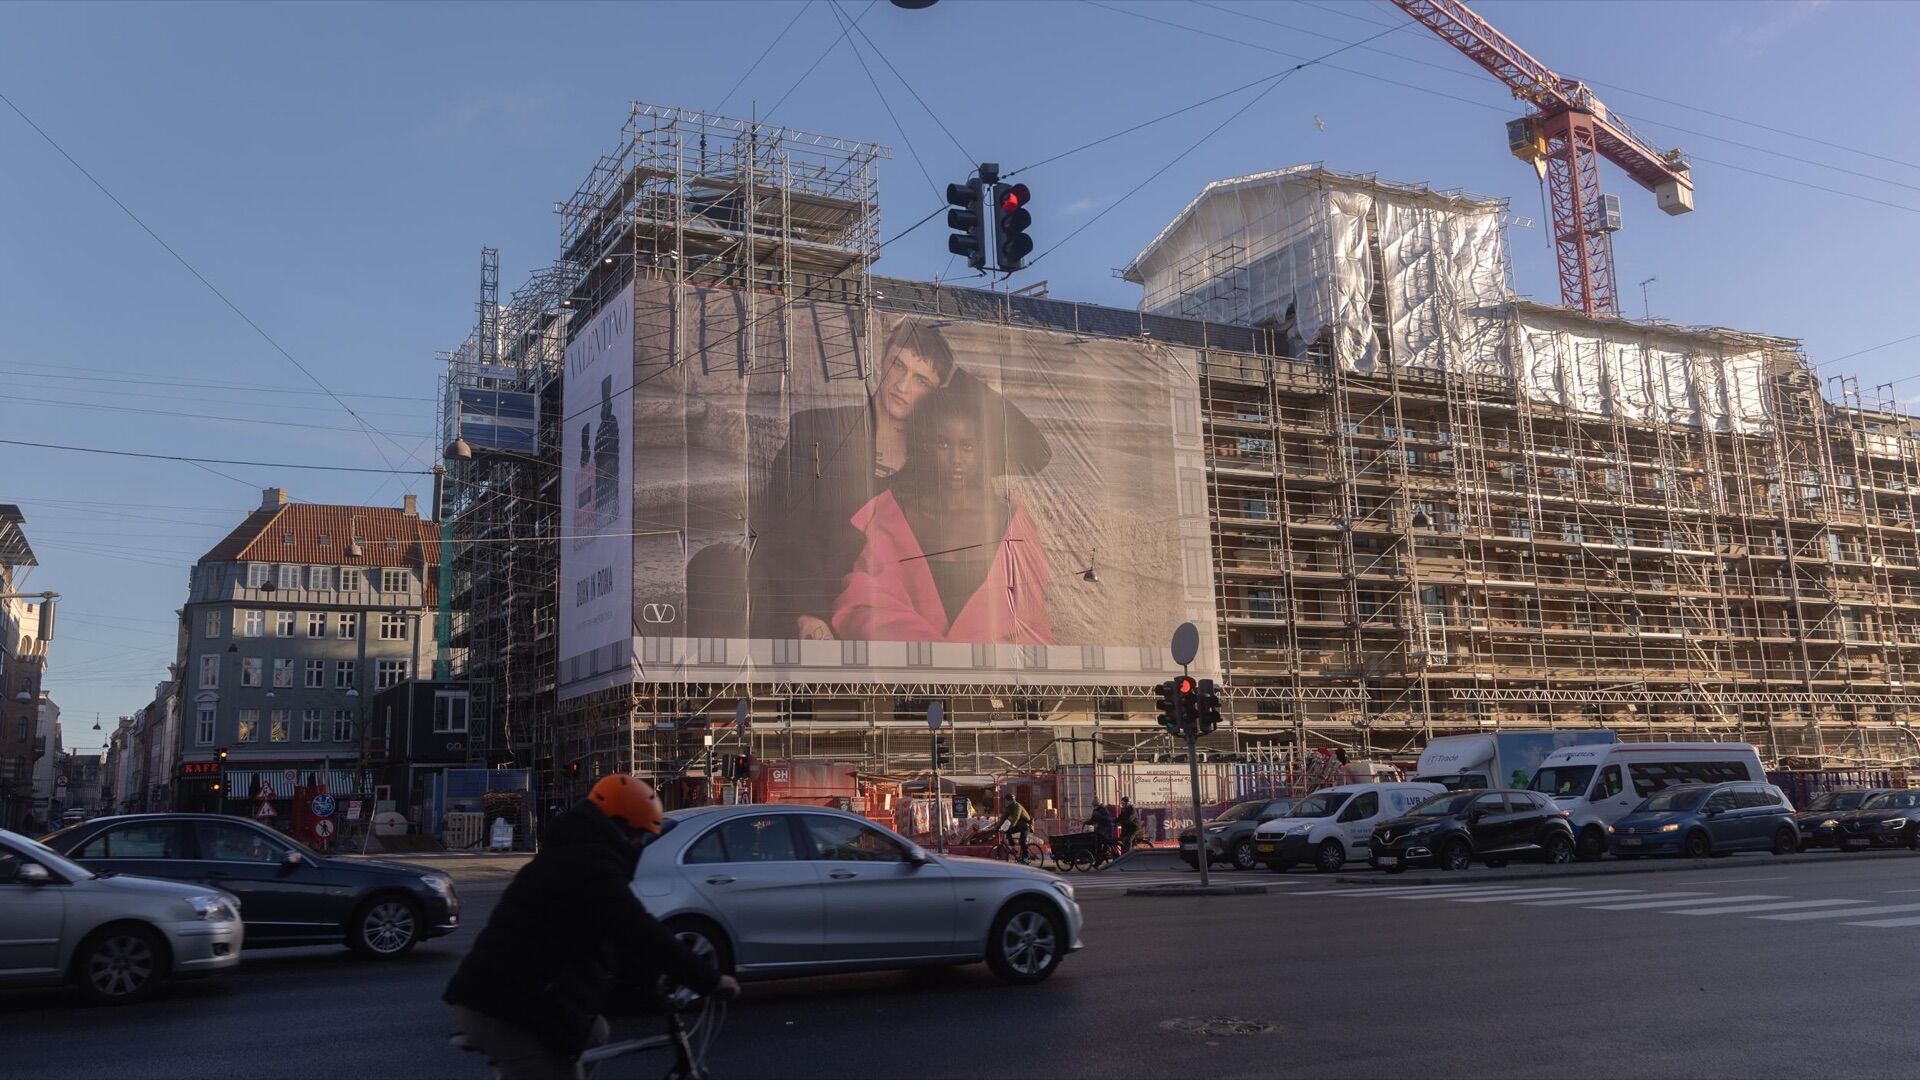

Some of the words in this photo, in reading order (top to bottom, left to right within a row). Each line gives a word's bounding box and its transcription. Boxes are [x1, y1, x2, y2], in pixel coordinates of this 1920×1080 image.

[570, 299, 628, 380] VALENTINO
[576, 577, 589, 608] BORN
[590, 573, 596, 601] IN
[597, 565, 614, 598] ROMA
[773, 770, 788, 779] GH
